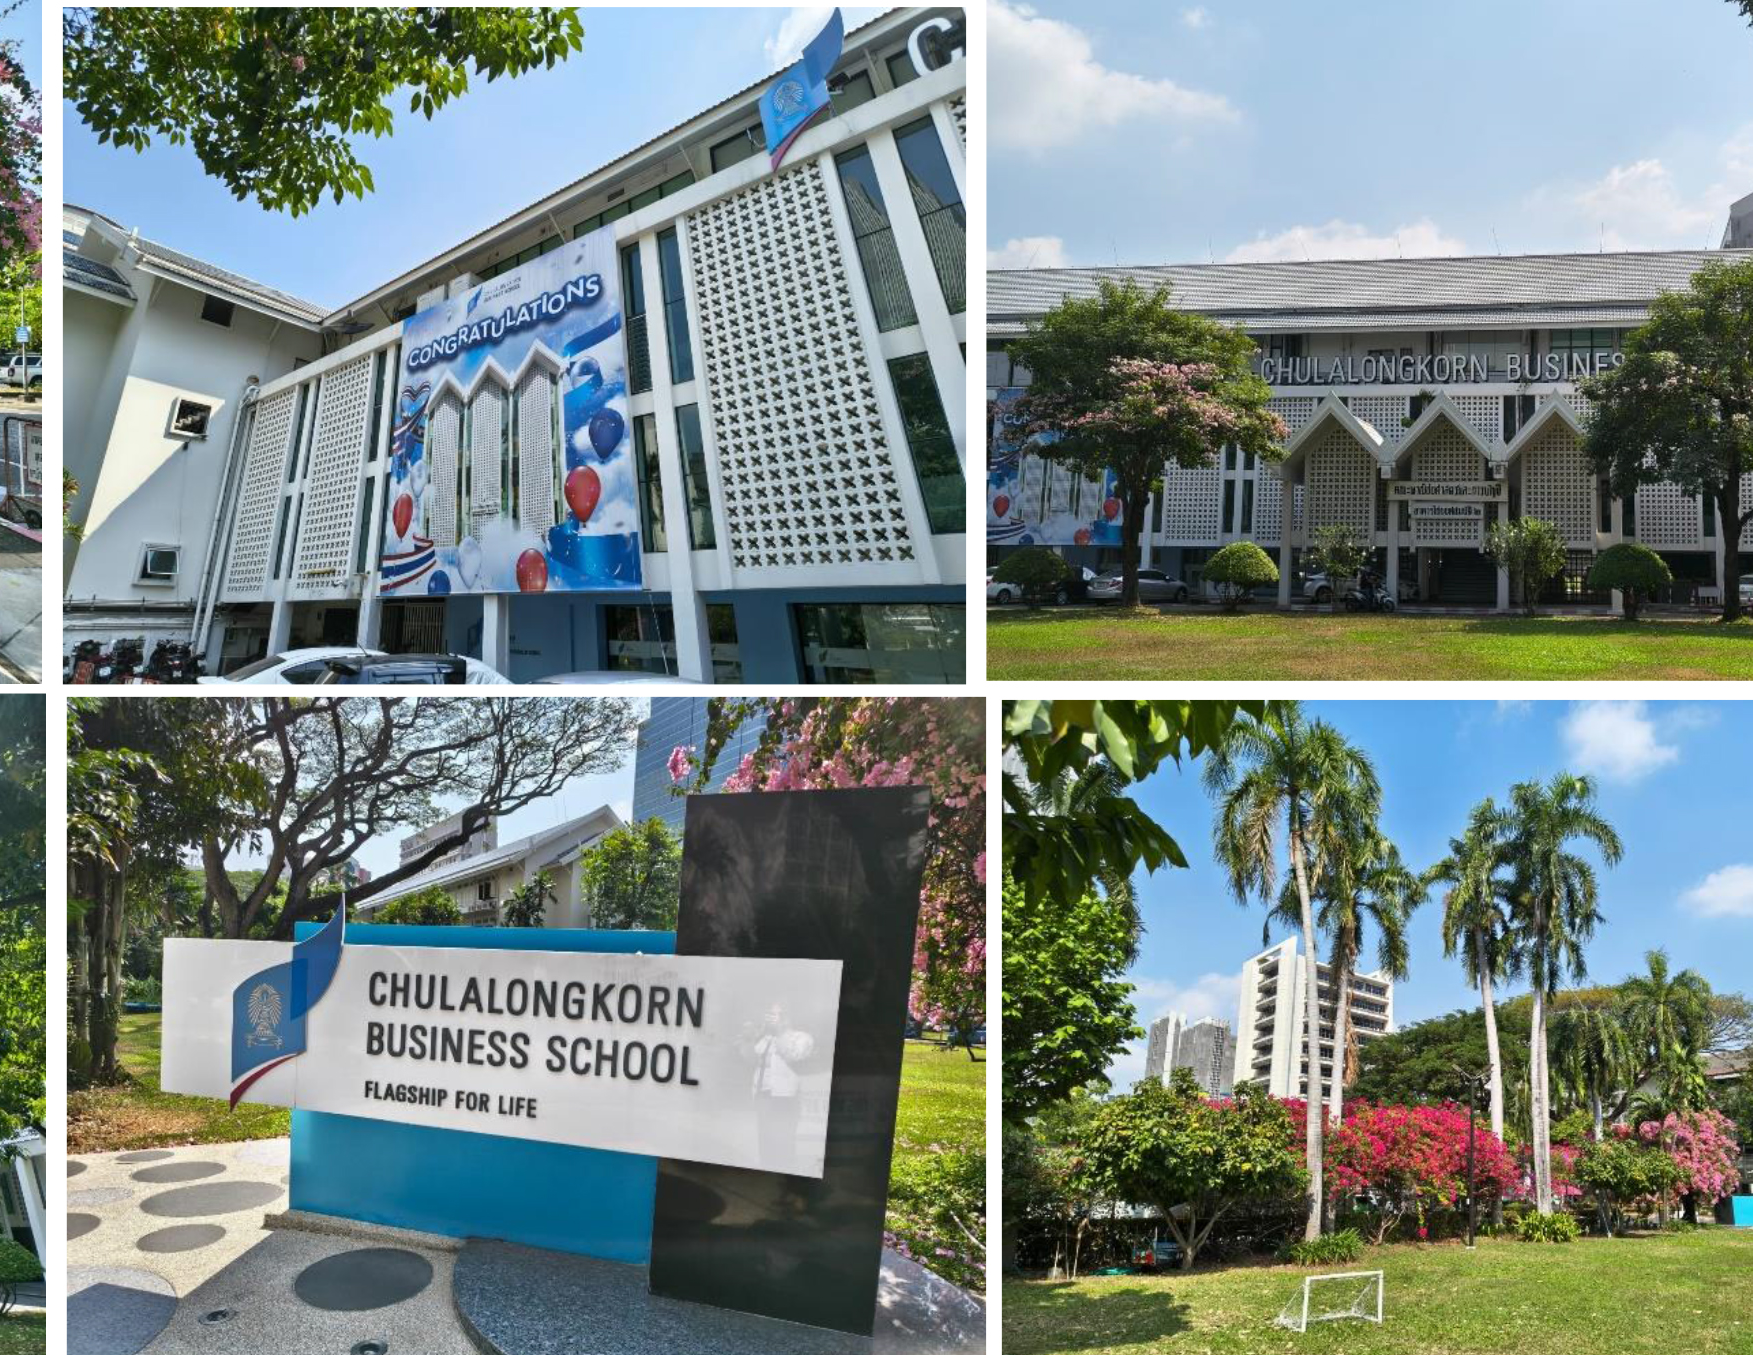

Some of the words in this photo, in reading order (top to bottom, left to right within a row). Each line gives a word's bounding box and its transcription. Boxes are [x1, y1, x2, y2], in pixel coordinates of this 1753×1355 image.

[408, 276, 602, 367] CONGRATULATIONS
[1260, 353, 1490, 384] CHULALONGKORN
[368, 971, 705, 1028] CHULALONGKORN
[365, 1021, 530, 1069] BUSINESS
[545, 1035, 699, 1086] SCHOOL
[364, 1080, 448, 1108] FLAGSHIP
[455, 1090, 490, 1113] FOR
[498, 1095, 537, 1119] LIFE
